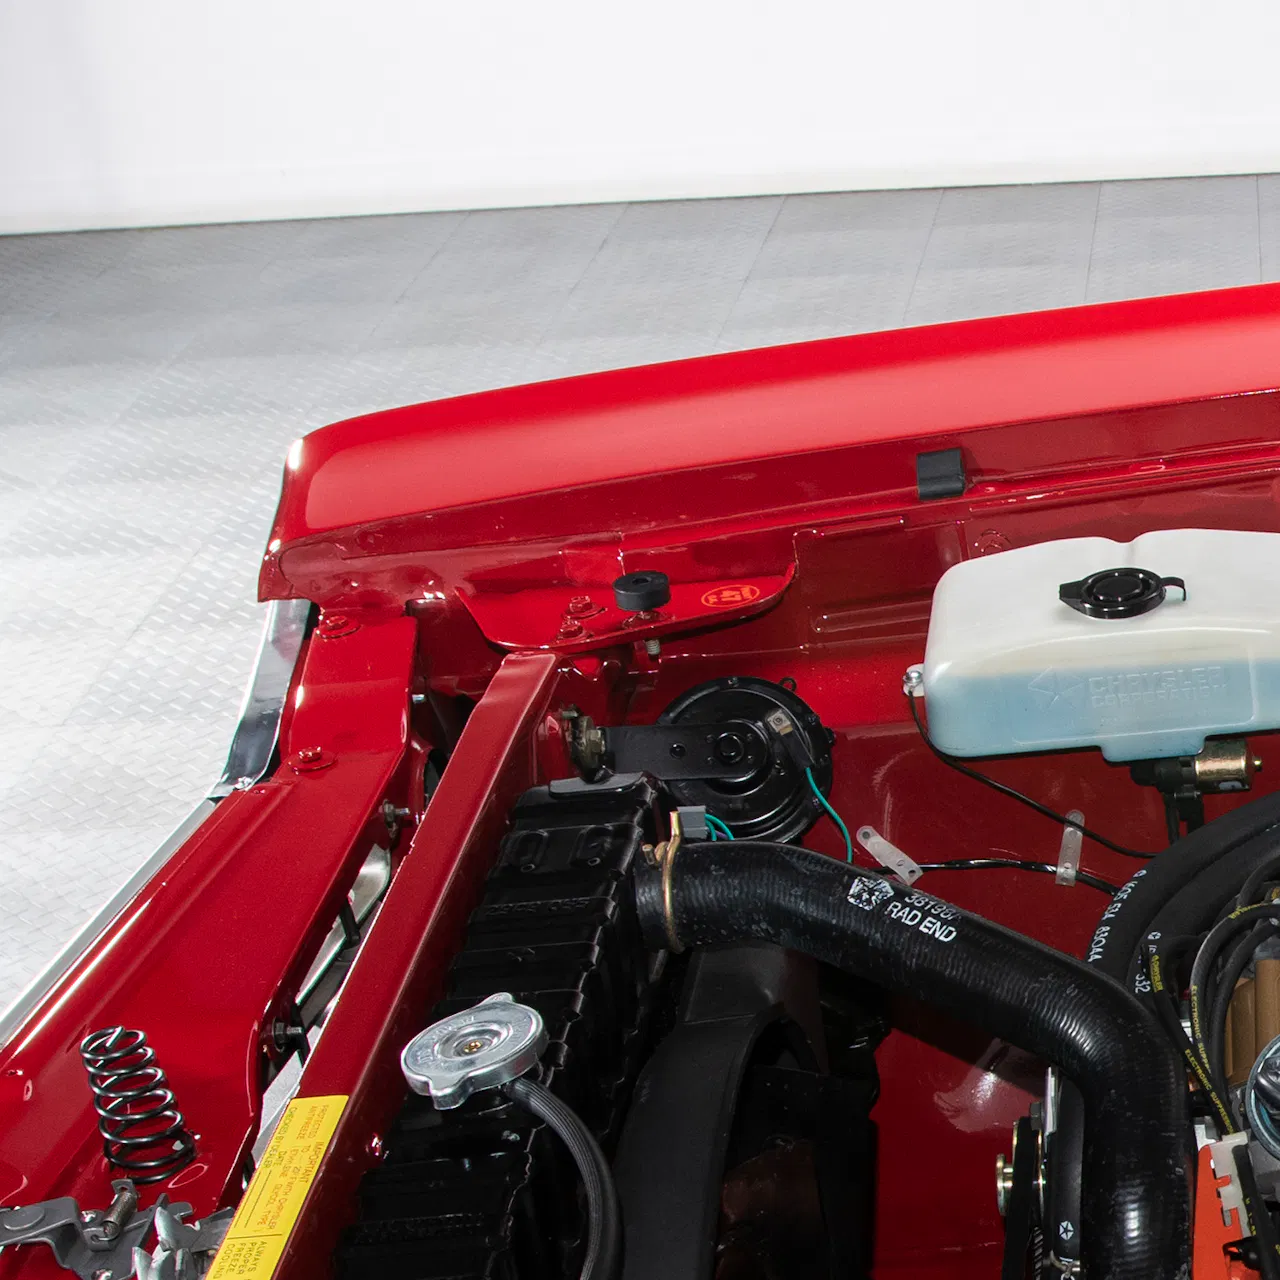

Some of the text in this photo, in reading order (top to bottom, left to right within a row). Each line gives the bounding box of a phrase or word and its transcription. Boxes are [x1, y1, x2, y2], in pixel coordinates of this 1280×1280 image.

[885, 901, 957, 942] RAD END
[1191, 985, 1202, 1040] ELECTRONIC
[1185, 1049, 1212, 1091] ELECTRONIC
[263, 1107, 297, 1169] CHECKED BY DEALER
[296, 1106, 317, 1140] ANTIFREEZE
[308, 1105, 329, 1138] PROTECTED
[274, 1151, 287, 1166] DATE
[300, 1142, 324, 1183] IMPORTANT
[301, 1145, 311, 1153] TO
[268, 1198, 288, 1229] CHRYSLER
[213, 1243, 235, 1279] COOLING
[236, 1242, 256, 1275] PROPER
[248, 1241, 267, 1272] ALWAYS
